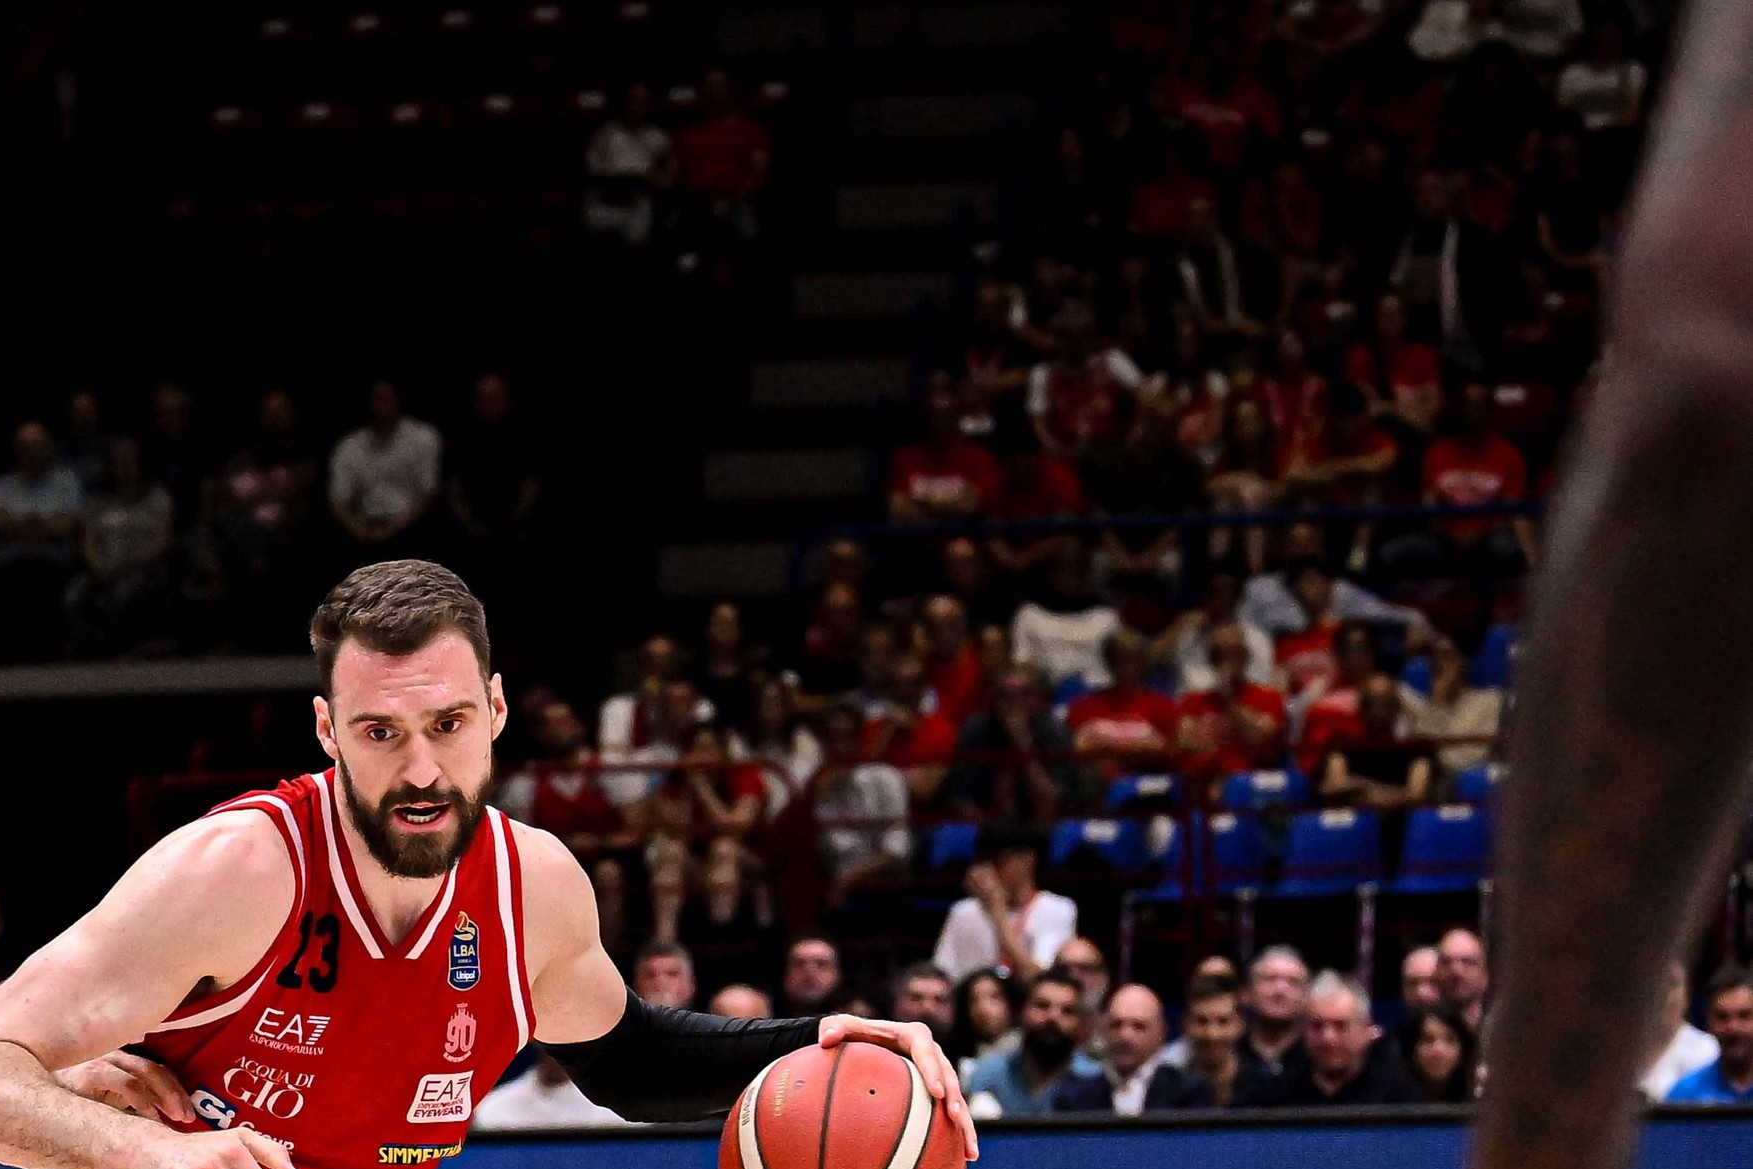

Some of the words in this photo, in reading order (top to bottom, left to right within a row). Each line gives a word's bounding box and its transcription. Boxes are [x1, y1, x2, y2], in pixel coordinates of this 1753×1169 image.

[275, 909, 341, 994] 23
[453, 944, 476, 957] LBA
[253, 1007, 331, 1046] EA7
[235, 1056, 289, 1085] ACQUA
[296, 1072, 316, 1089] DI
[420, 1077, 471, 1102] EA7
[413, 1105, 464, 1118] EYEWEAR
